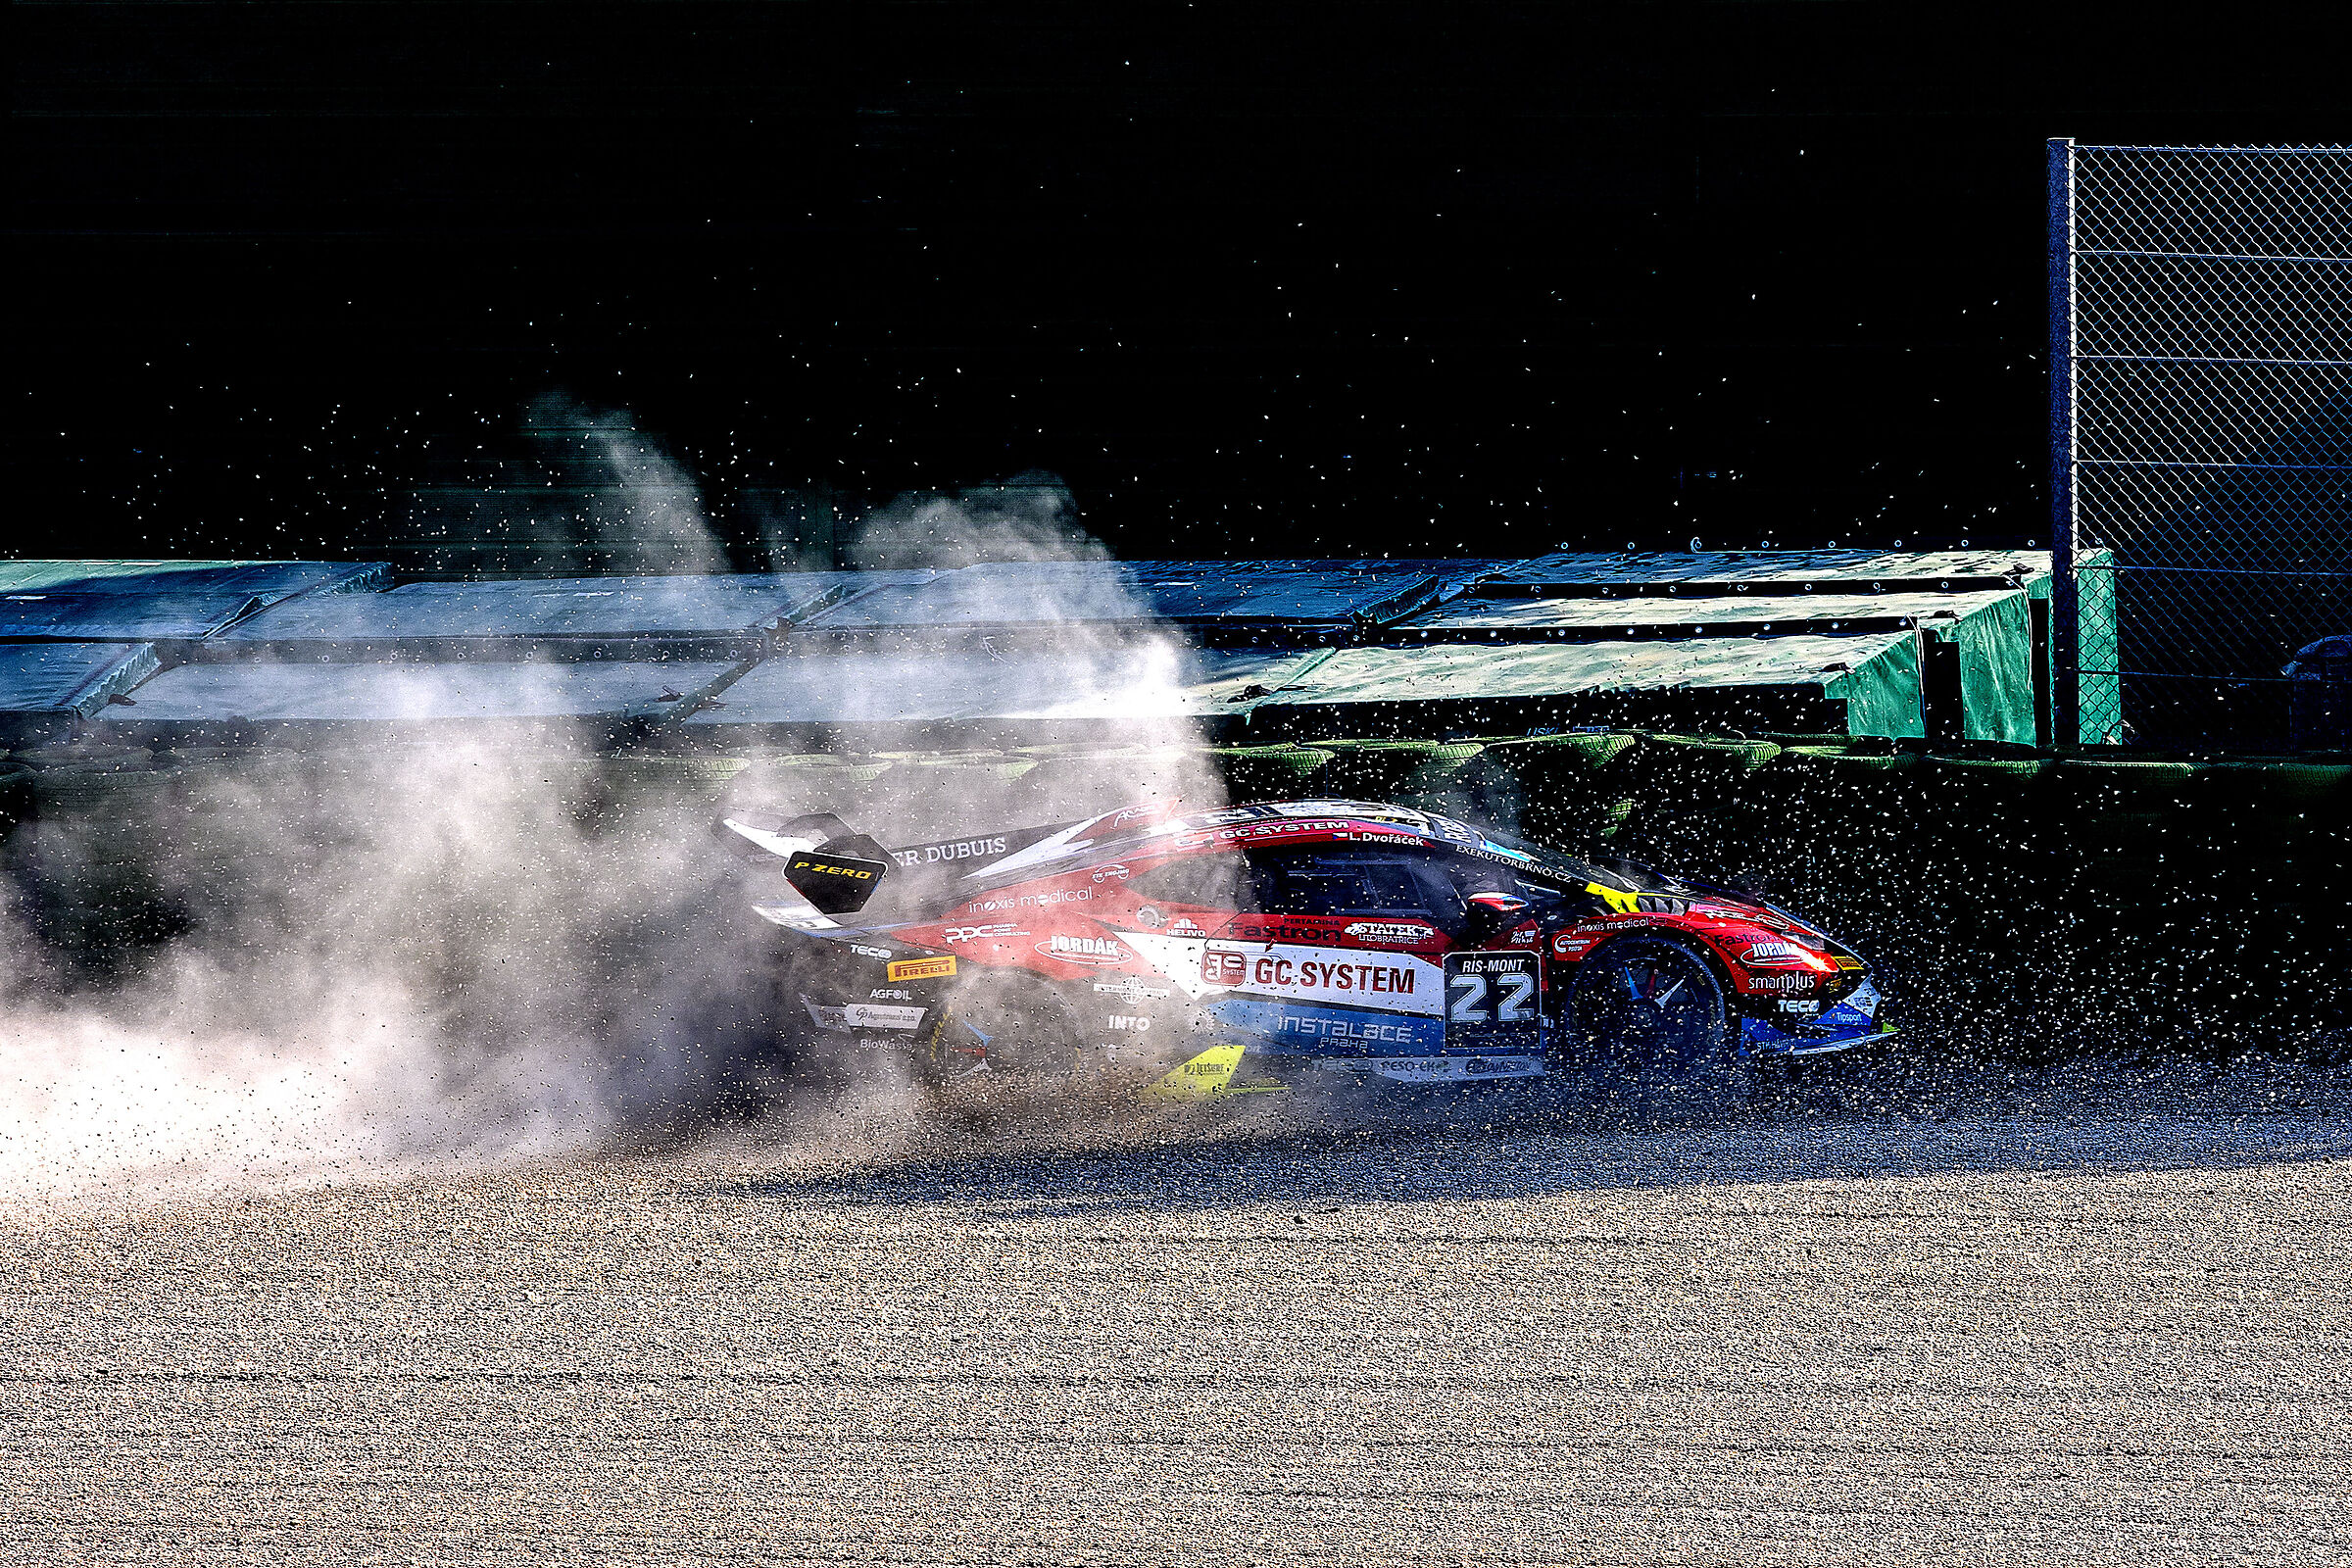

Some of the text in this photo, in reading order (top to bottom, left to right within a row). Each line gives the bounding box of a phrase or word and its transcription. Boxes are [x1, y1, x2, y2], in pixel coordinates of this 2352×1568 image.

[1219, 821, 1349, 839] GC SYSTEM
[1362, 832, 1424, 847] Dvořáček
[924, 837, 1007, 863] DUBUIS
[793, 861, 873, 881] P ZERO
[1455, 844, 1572, 883] EXEKUTORBRNO.CZ
[968, 886, 1093, 914] inoxis medical
[1166, 928, 1206, 938] HELIVO
[1228, 922, 1342, 943] Fastron
[1577, 916, 1649, 933] inoxis medical
[1050, 935, 1119, 956] JORDÁK
[1358, 934, 1420, 945] LITOBRATRICE
[850, 944, 893, 959] TECO
[894, 959, 951, 978] PIRELLI
[1222, 968, 1246, 977] SYSTEM
[1461, 958, 1525, 973] RIS-MONT
[1254, 957, 1416, 995] GC SYSTEM
[1748, 970, 1815, 993] smartplus
[869, 989, 912, 1002] AGFOIL
[1449, 972, 1535, 1023] 22
[1777, 999, 1821, 1013] TECO
[1107, 1014, 1151, 1032] INTO
[1836, 1011, 1863, 1024] Tipsport
